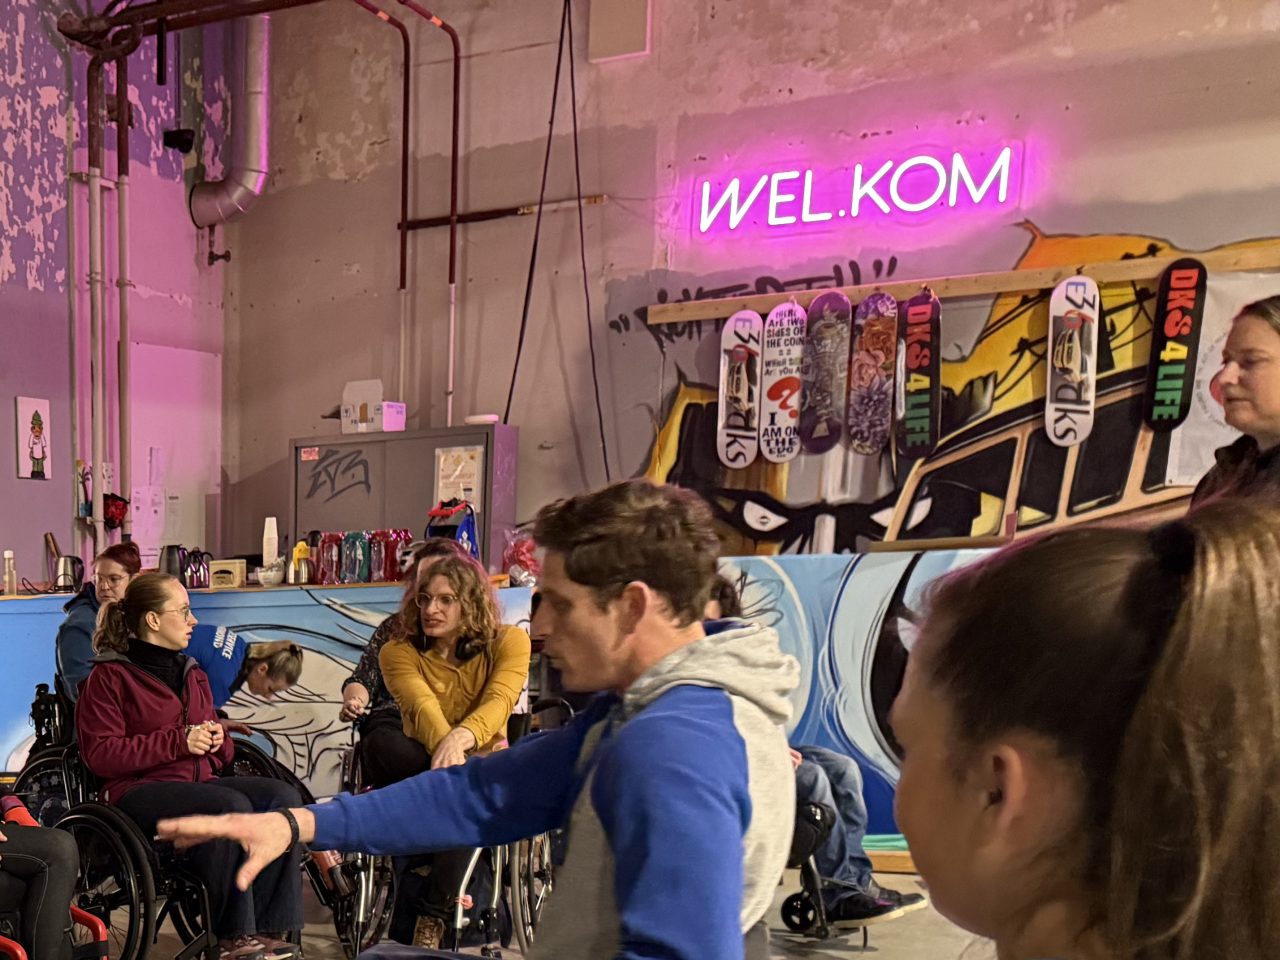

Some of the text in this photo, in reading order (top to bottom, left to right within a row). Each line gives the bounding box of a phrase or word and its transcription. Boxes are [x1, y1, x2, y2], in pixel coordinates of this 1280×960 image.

[700, 147, 1011, 232] WEL.KOM
[1151, 268, 1200, 421] DKS 4 LIFE
[905, 303, 933, 448] DKS 4 LIFE
[762, 427, 782, 438] AM
[762, 437, 798, 448] THE
[768, 412, 778, 426] I
